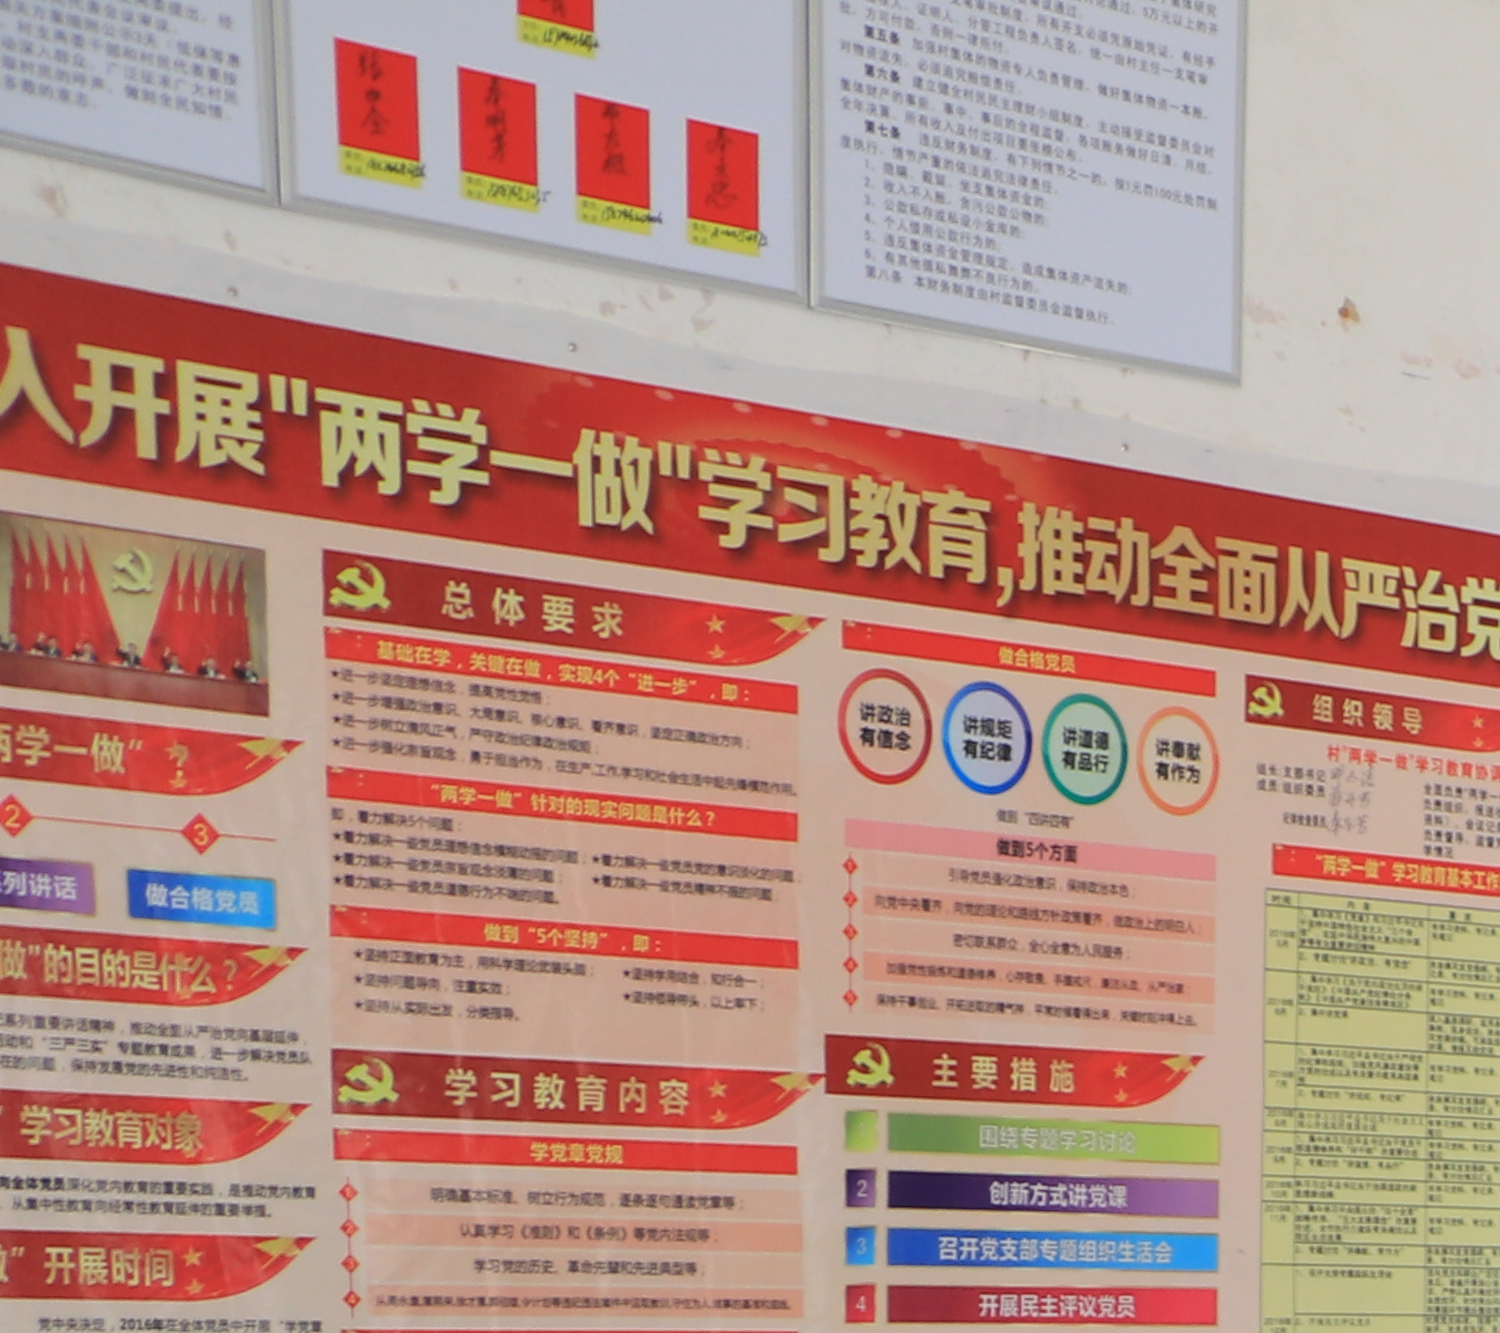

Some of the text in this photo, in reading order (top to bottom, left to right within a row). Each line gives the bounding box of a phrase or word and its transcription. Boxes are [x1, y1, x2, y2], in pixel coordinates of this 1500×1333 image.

[441, 579, 625, 639] 总体要求
[998, 645, 1077, 674] 做合格党员
[858, 701, 911, 728] 讲政治
[962, 714, 1013, 740] 讲规矩
[1311, 693, 1424, 736] 组织领导
[858, 726, 912, 753] 有信念
[962, 738, 1013, 763] 有纪律
[1061, 725, 1110, 752] 讲道德
[1155, 737, 1202, 762] 讲奉献
[1061, 749, 1110, 775] 有品行
[1155, 760, 1202, 785] 有作为
[4, 803, 21, 829] 2
[193, 821, 209, 847] 3
[996, 838, 1078, 863] 做到5个方面
[0, 869, 78, 901] 列讲话
[145, 882, 260, 915] 做合格党员
[931, 1052, 1076, 1094] 主要措施
[444, 1067, 691, 1117] 学习教育内容
[19, 1104, 204, 1153] 学习教育对象
[979, 1124, 1136, 1155] 围绕专题学习讨论
[529, 1140, 625, 1166] 学党章党规
[856, 1179, 869, 1198] 2
[989, 1180, 1129, 1210] 创新方式讲党课
[855, 1238, 868, 1256] 3
[937, 1235, 1173, 1265] 召开党支部专题组织生活会
[0, 1245, 176, 1288] ”开展时间
[854, 1295, 867, 1312] 4
[978, 1293, 1137, 1320] 开展民主评议党员
